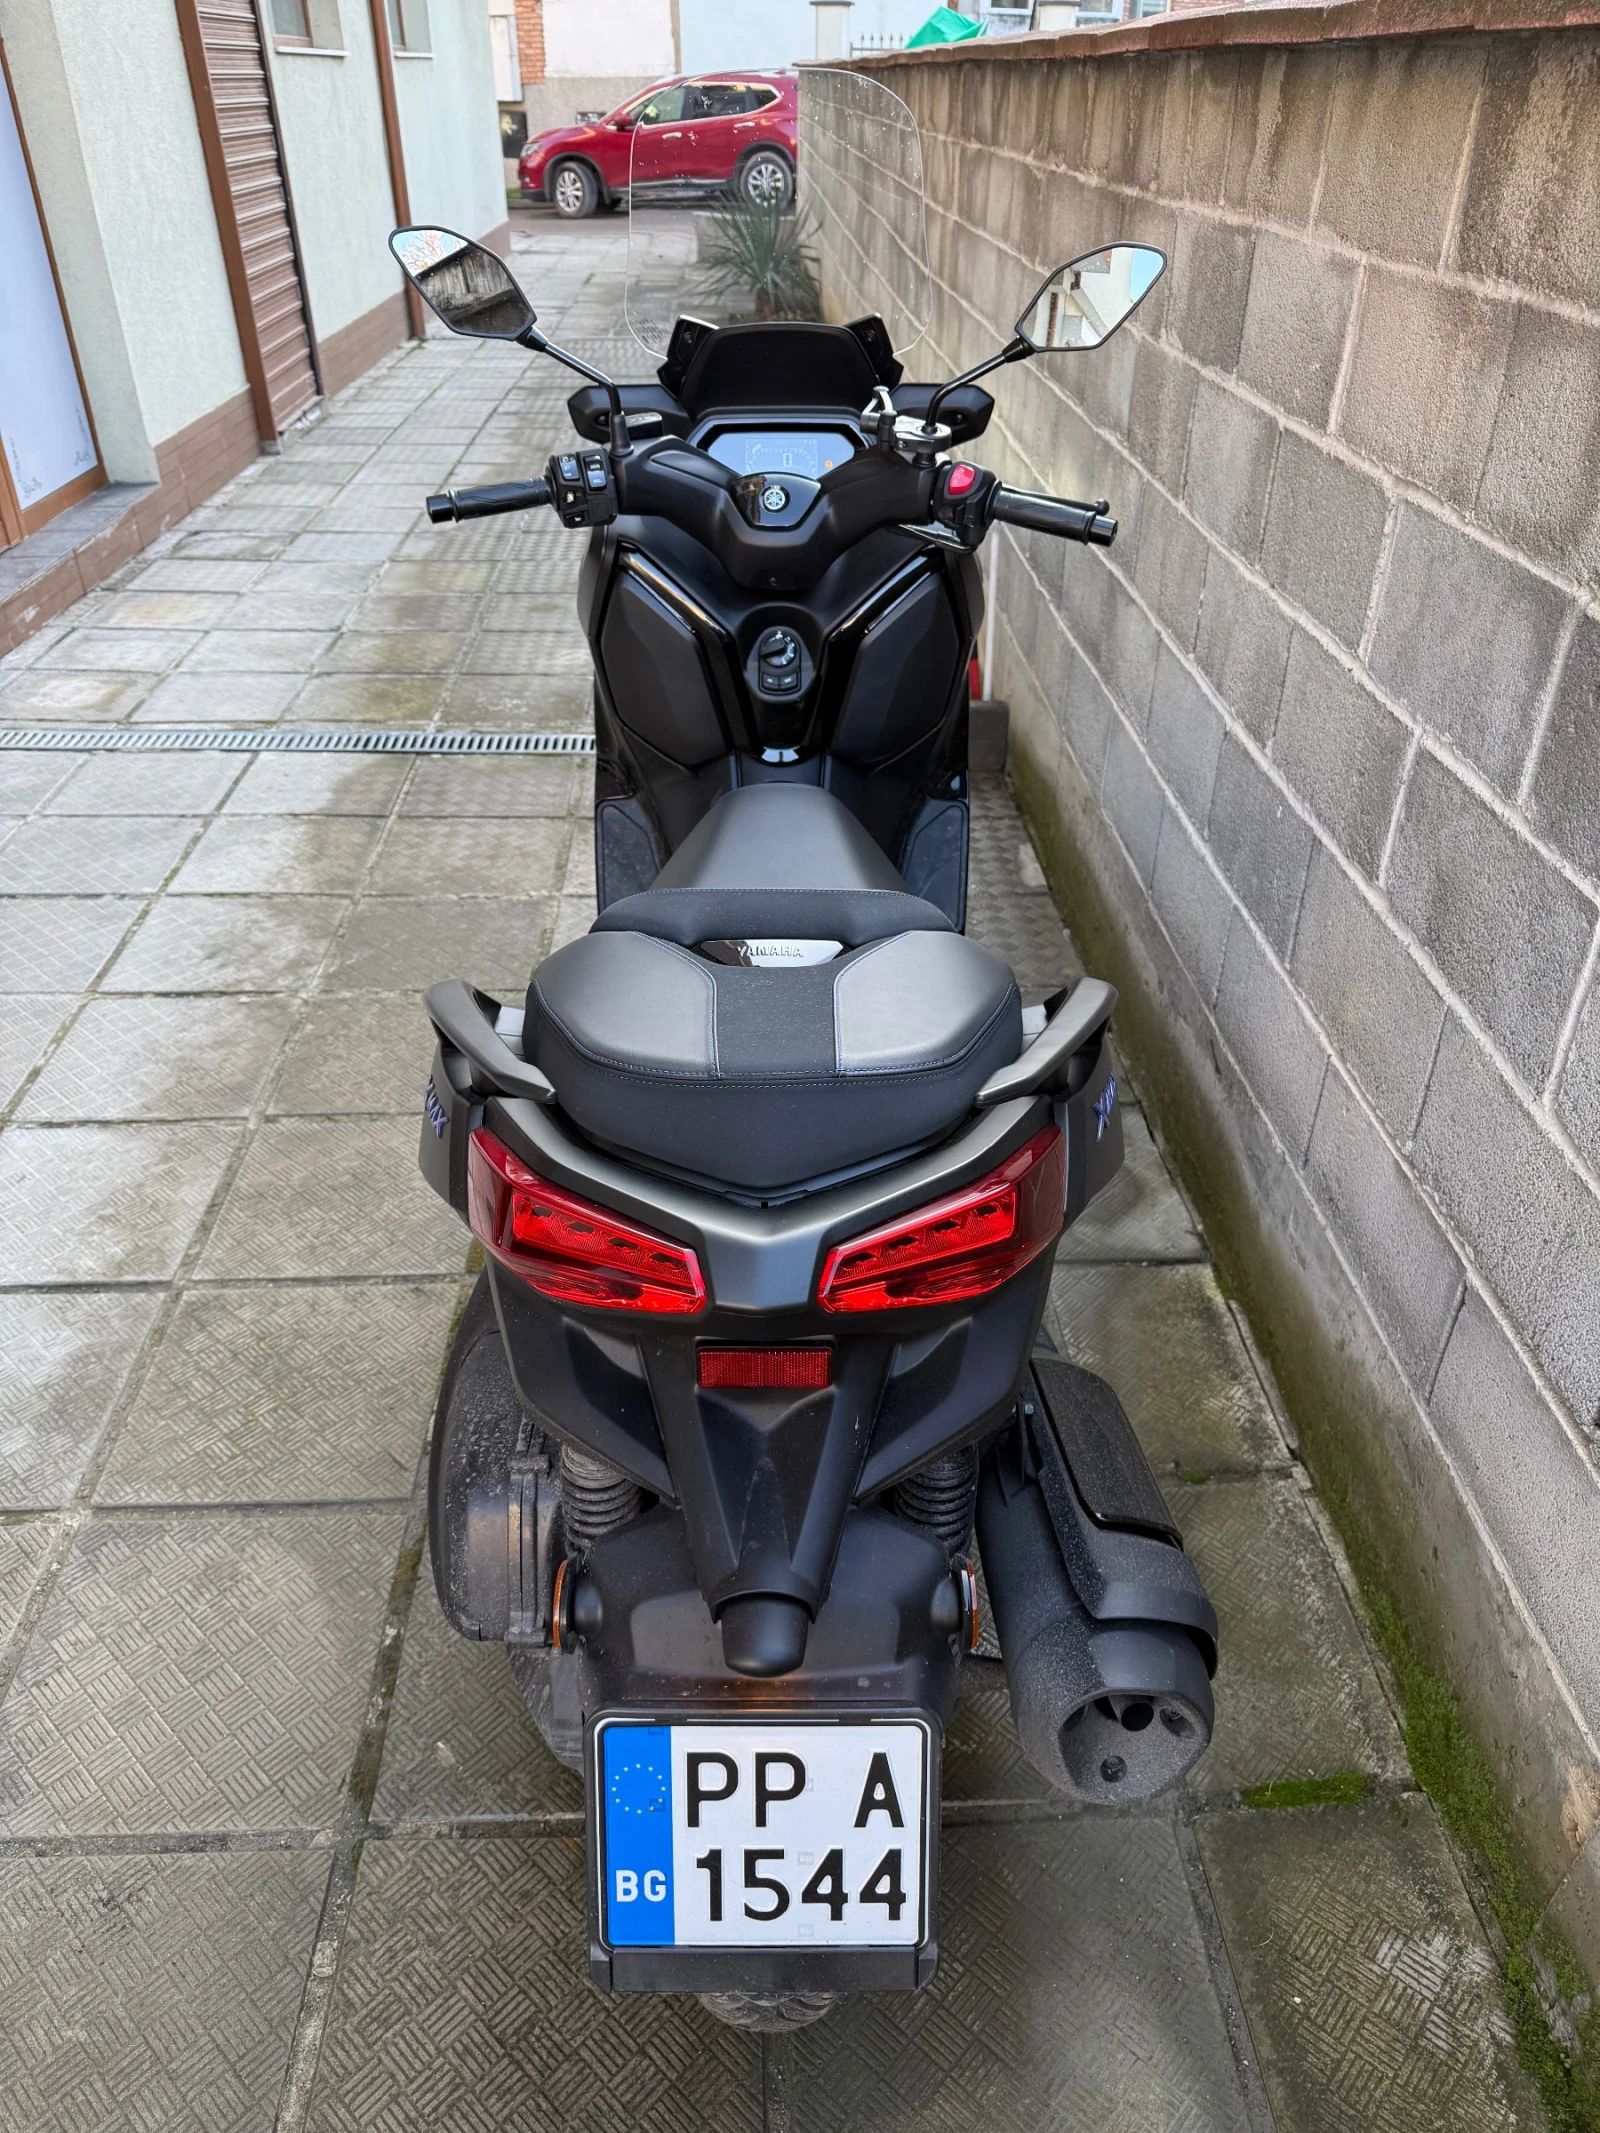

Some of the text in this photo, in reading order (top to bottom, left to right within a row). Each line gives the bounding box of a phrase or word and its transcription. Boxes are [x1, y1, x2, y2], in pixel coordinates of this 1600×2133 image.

[737, 945, 804, 957] YAMAHA
[686, 1752, 905, 1828] PP A
[615, 1869, 667, 1903] BG
[696, 1848, 907, 1922] 1544
